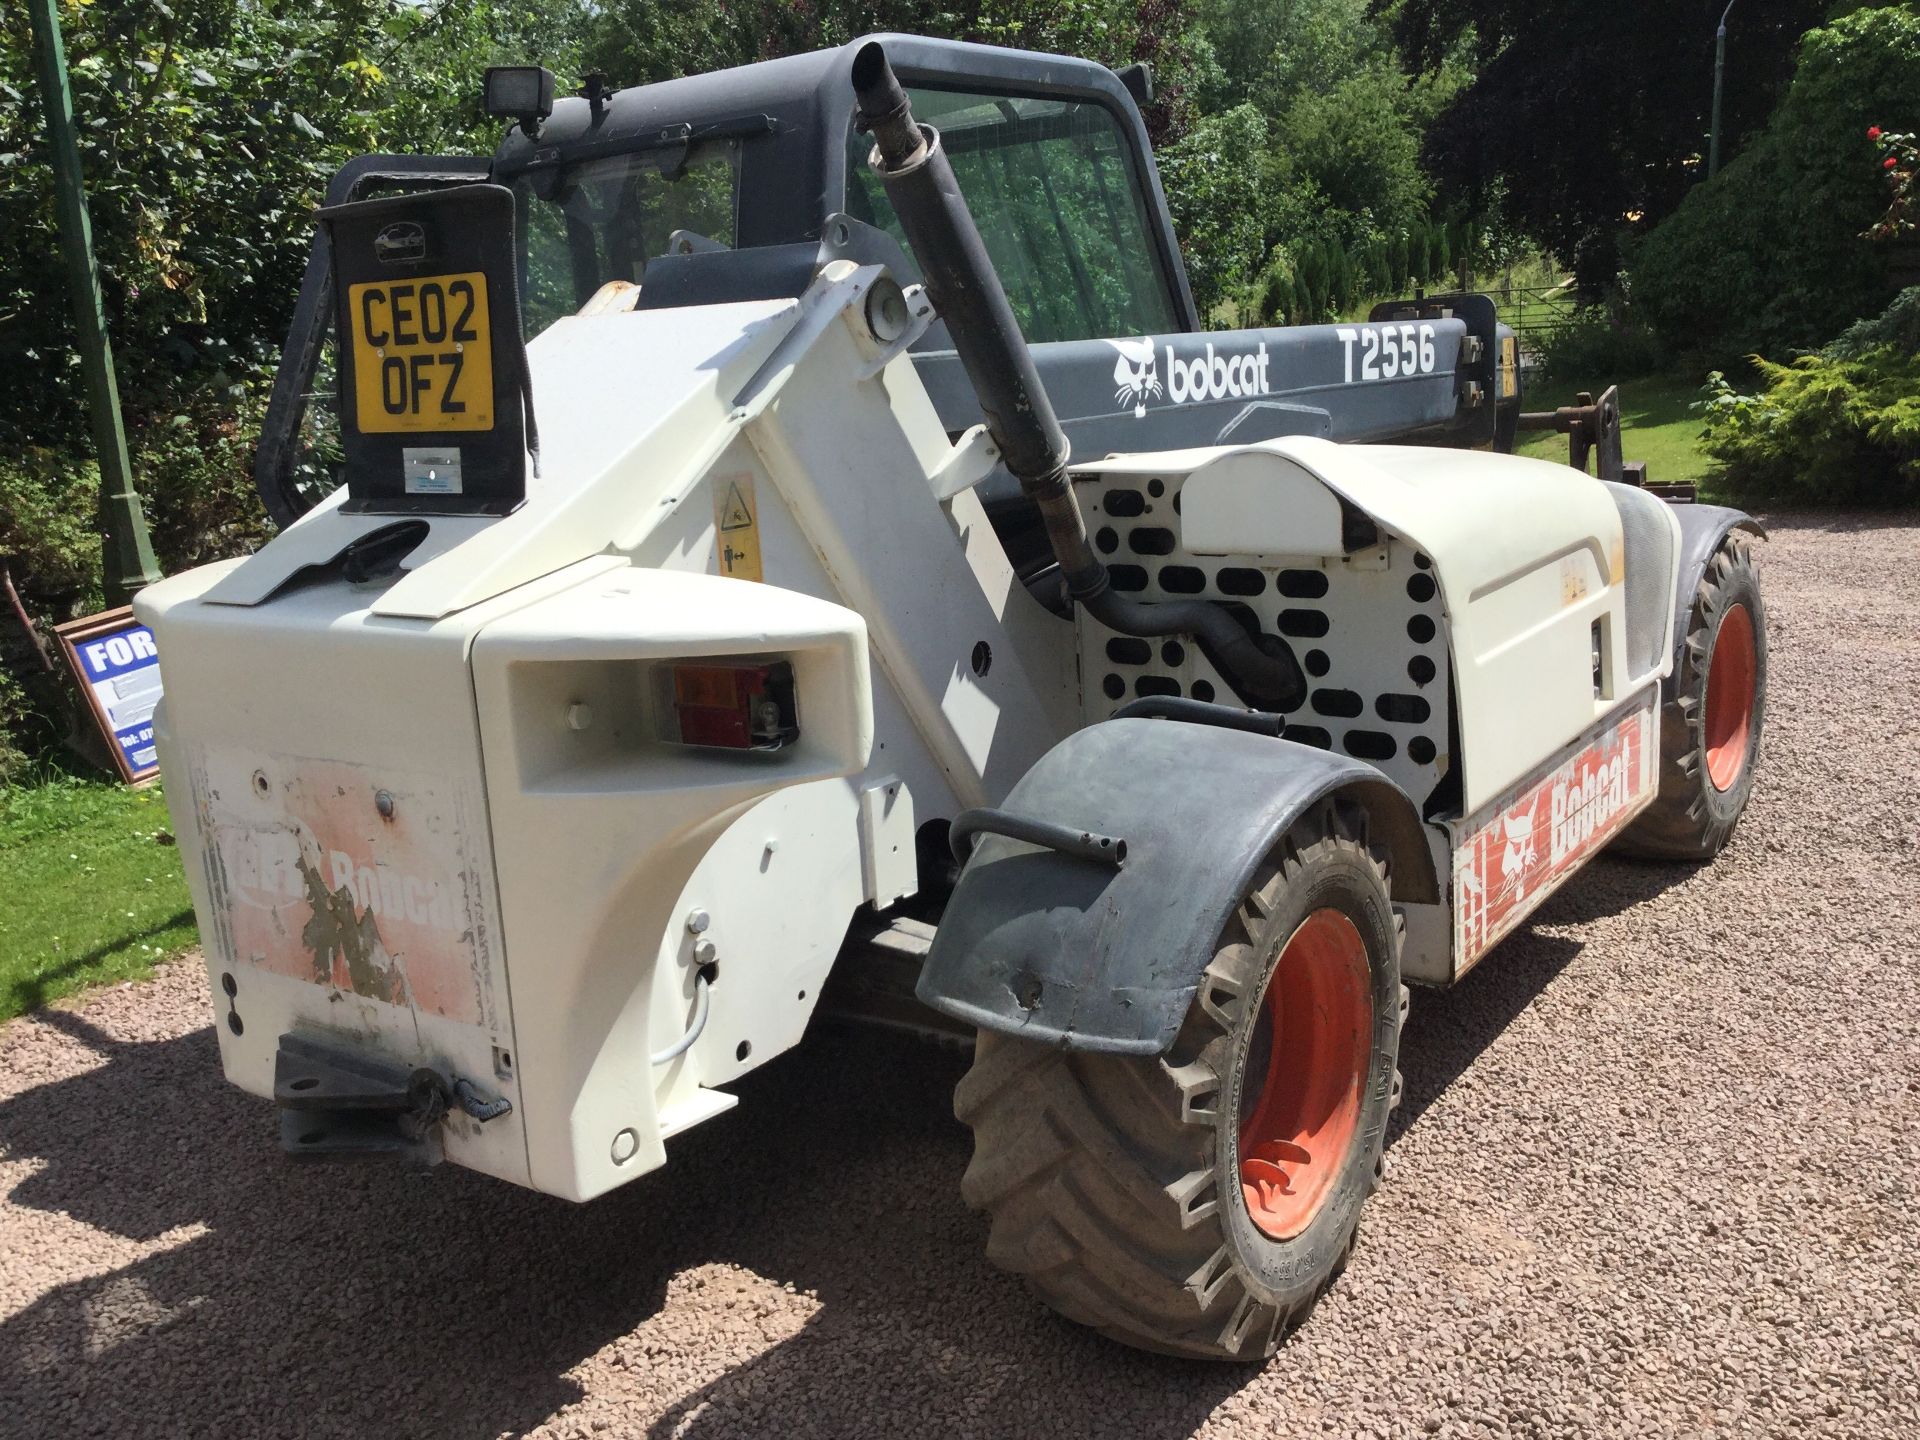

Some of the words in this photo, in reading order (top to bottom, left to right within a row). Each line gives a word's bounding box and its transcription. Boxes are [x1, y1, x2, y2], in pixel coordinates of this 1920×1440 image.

[362, 280, 477, 347] CE02
[382, 353, 465, 415] OFZ
[1166, 342, 1270, 403] bobcat
[1336, 324, 1436, 383] T2556
[85, 630, 158, 673] FOR
[118, 734, 140, 748] Tel:
[1551, 736, 1630, 864] Bobcat
